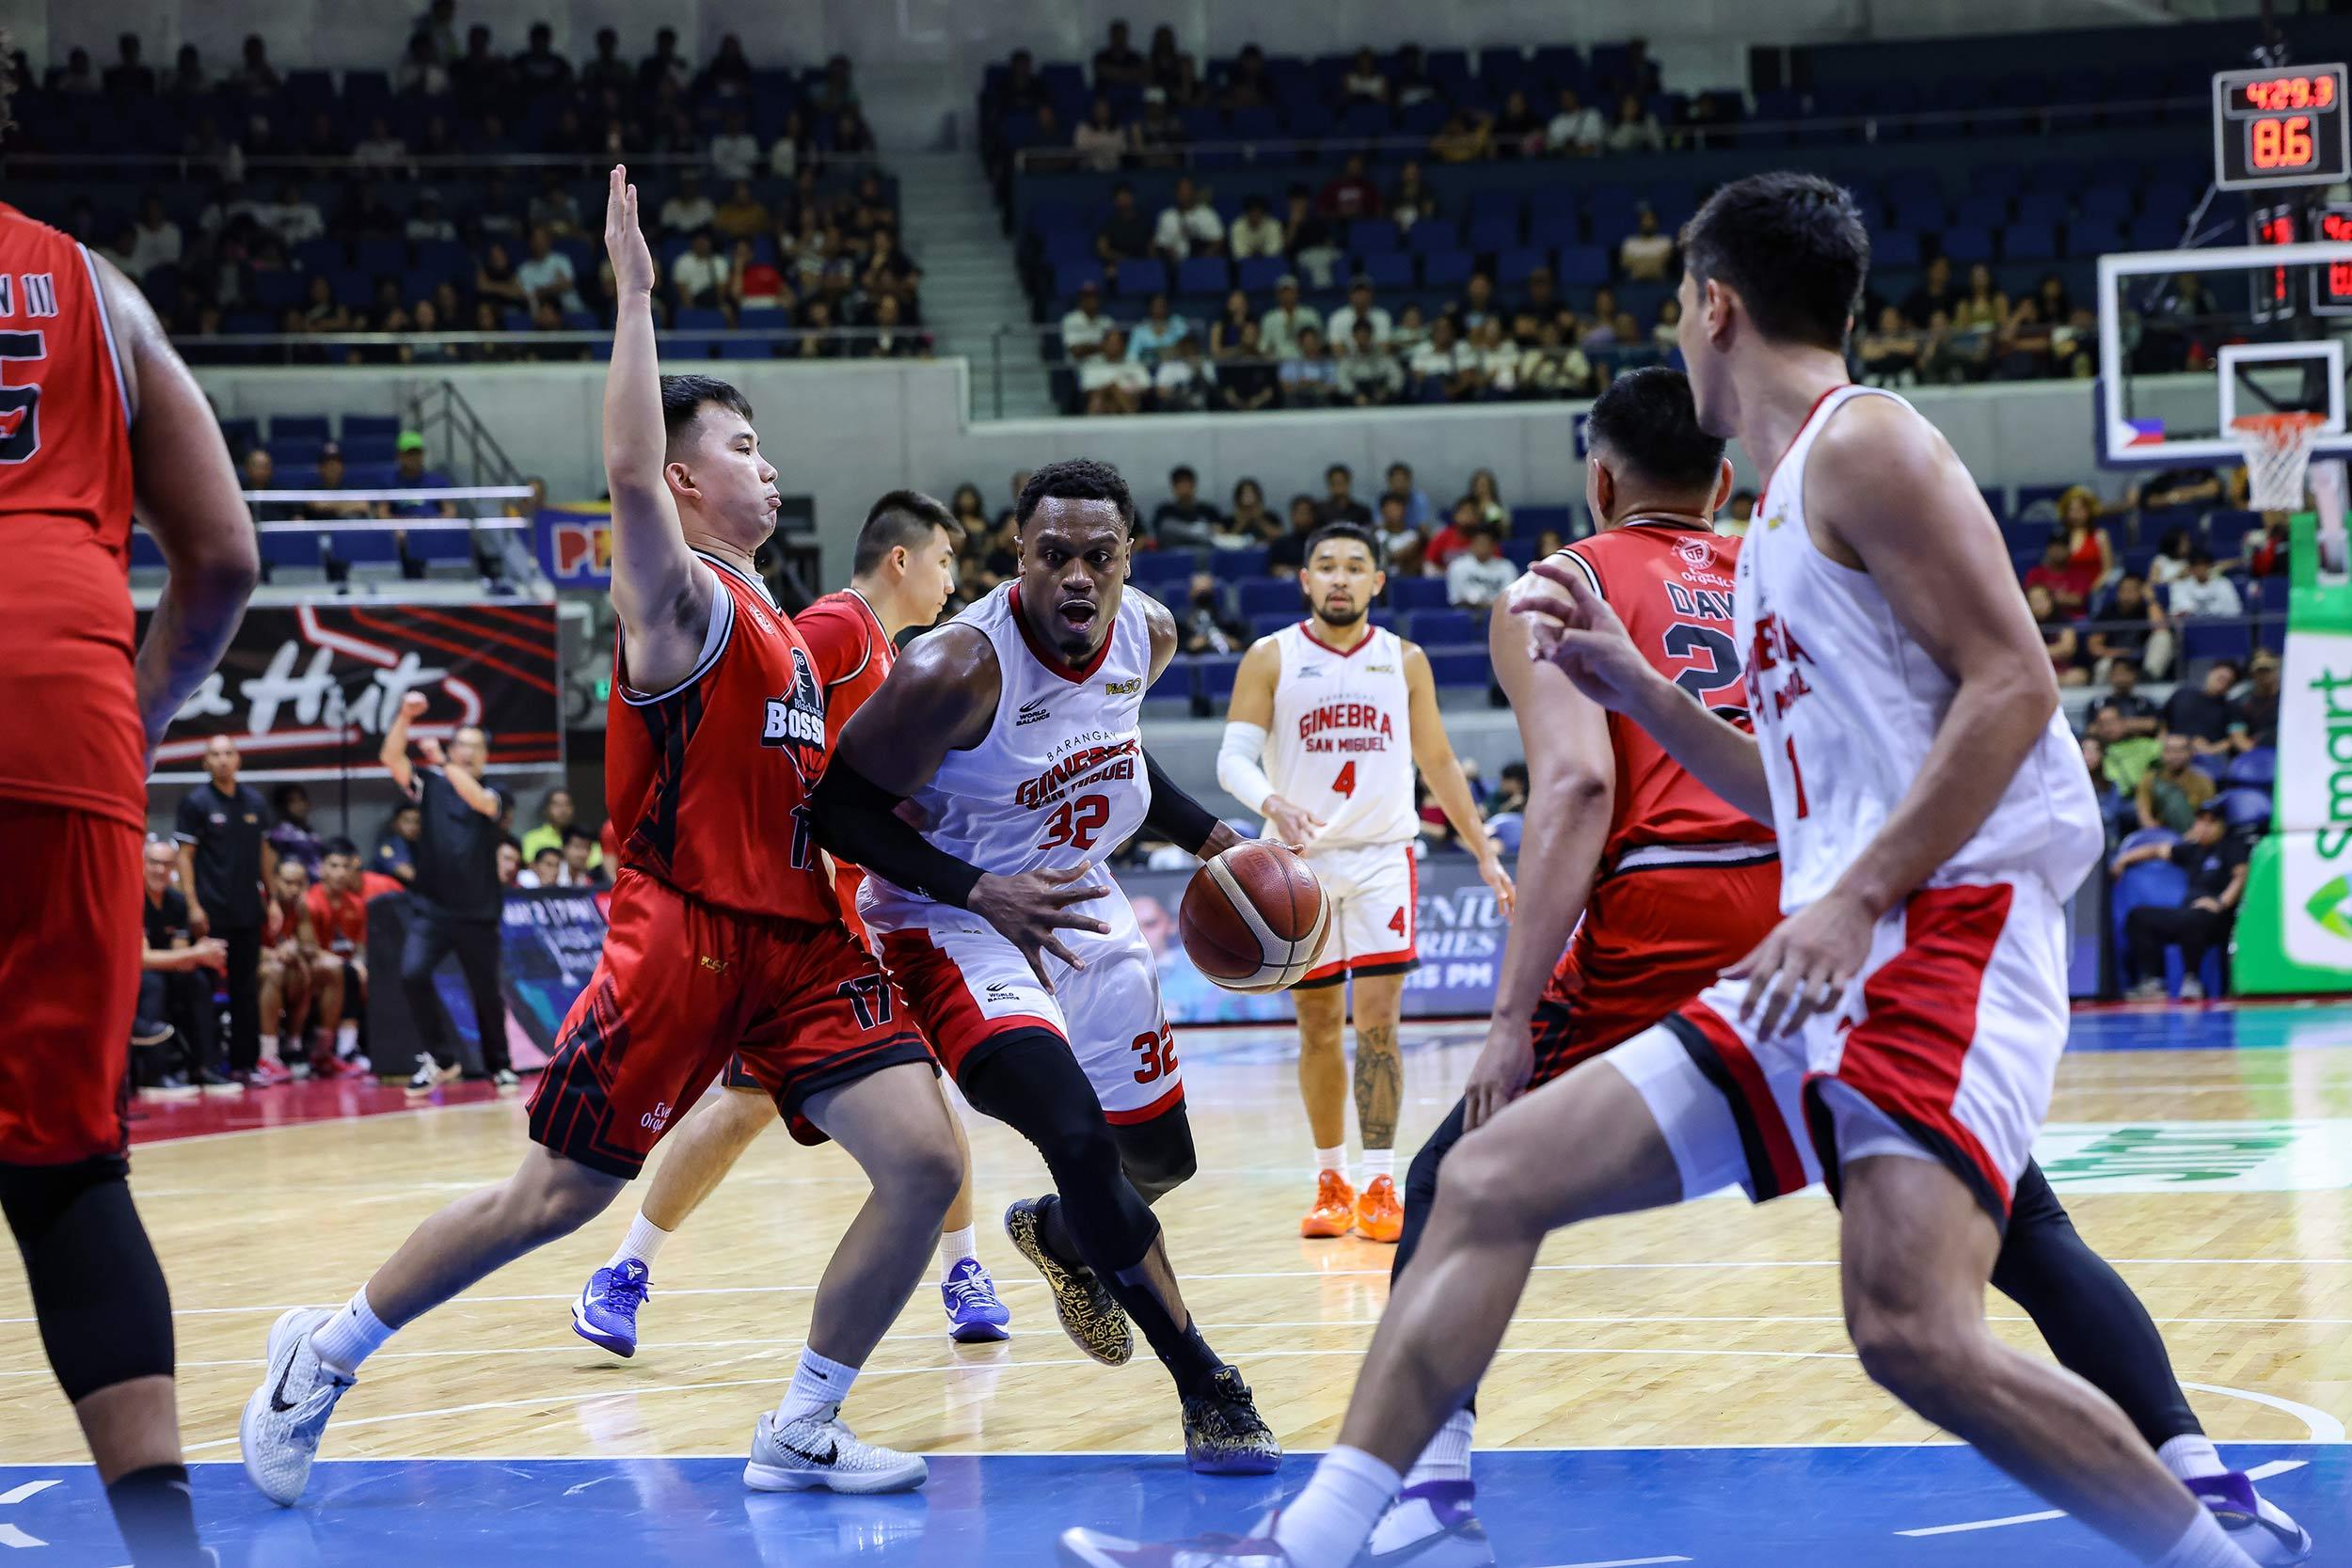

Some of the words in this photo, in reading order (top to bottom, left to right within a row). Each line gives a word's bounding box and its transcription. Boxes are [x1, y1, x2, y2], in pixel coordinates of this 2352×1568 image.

[2252, 116, 2312, 168] 8.6
[240, 640, 449, 736] Hut
[1015, 712, 1051, 727] BALANCE
[1019, 708, 1047, 721] WORLD
[1298, 704, 1394, 741] GINEBRA
[1045, 730, 1120, 763] BARANGAY
[1306, 737, 1334, 753] SAN
[1338, 736, 1387, 753] MIGUEL
[1332, 760, 1357, 800] 4
[789, 803, 822, 872] 1
[1037, 794, 1111, 851] 32
[1387, 906, 1406, 938] 4
[836, 973, 893, 1032] 17
[1131, 1019, 1180, 1085] 32
